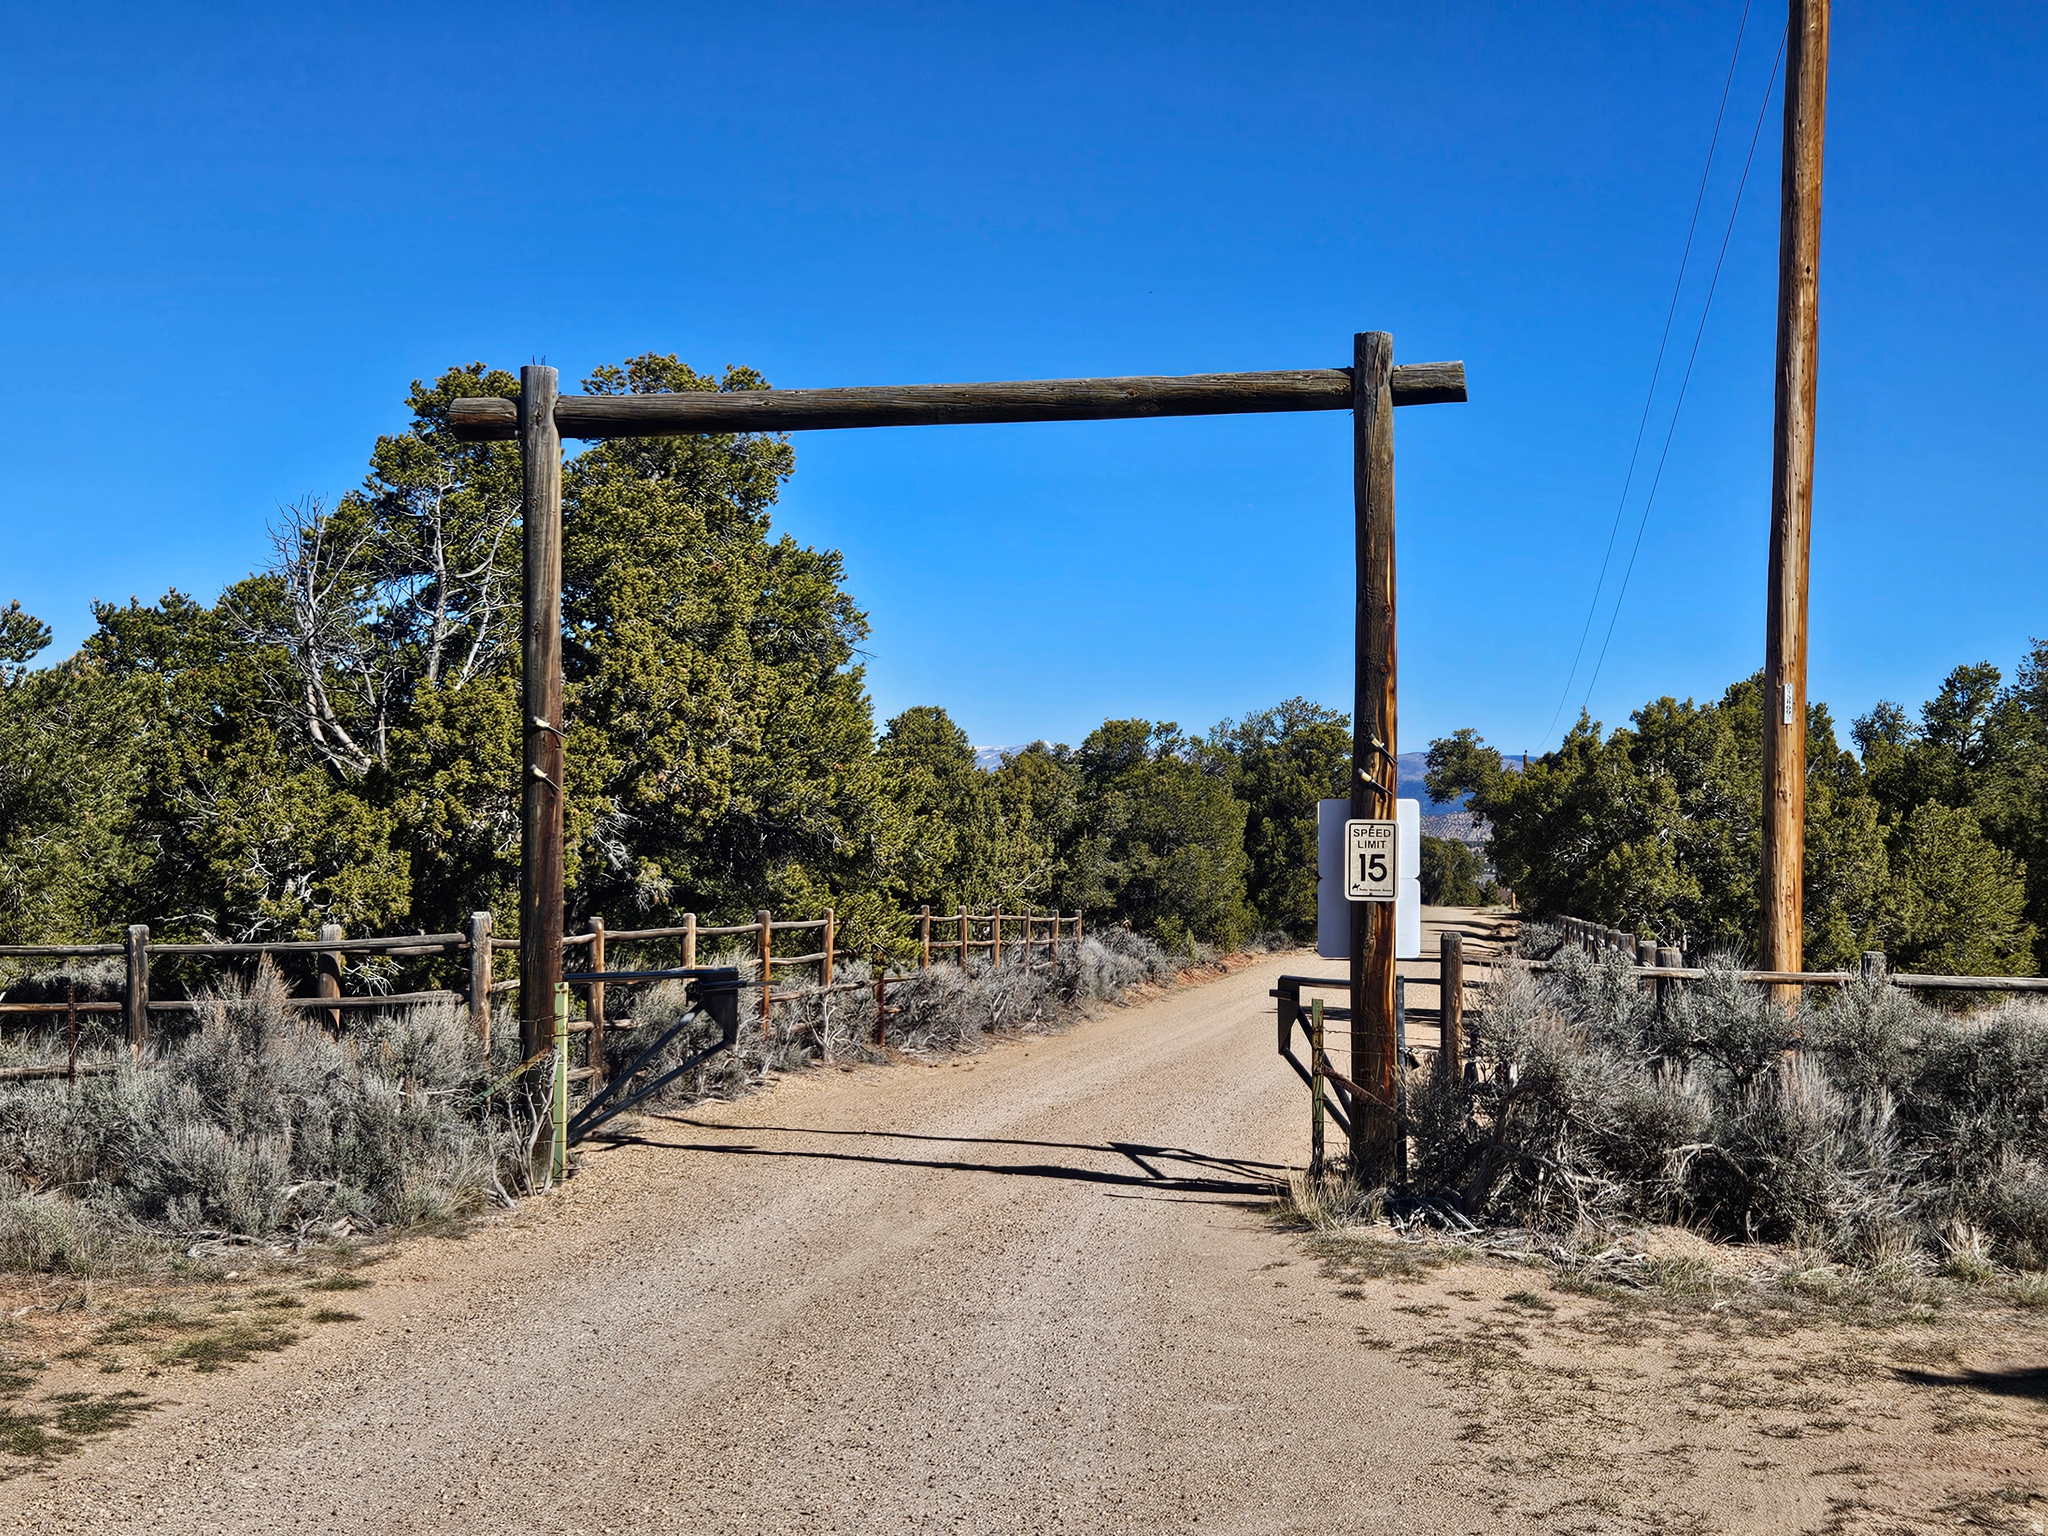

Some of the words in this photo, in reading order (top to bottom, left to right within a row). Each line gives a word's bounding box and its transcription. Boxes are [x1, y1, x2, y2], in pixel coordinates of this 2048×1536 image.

[1353, 829, 1391, 838] SPEED
[1358, 840, 1386, 849] LIMIT
[1359, 854, 1387, 882] 15
